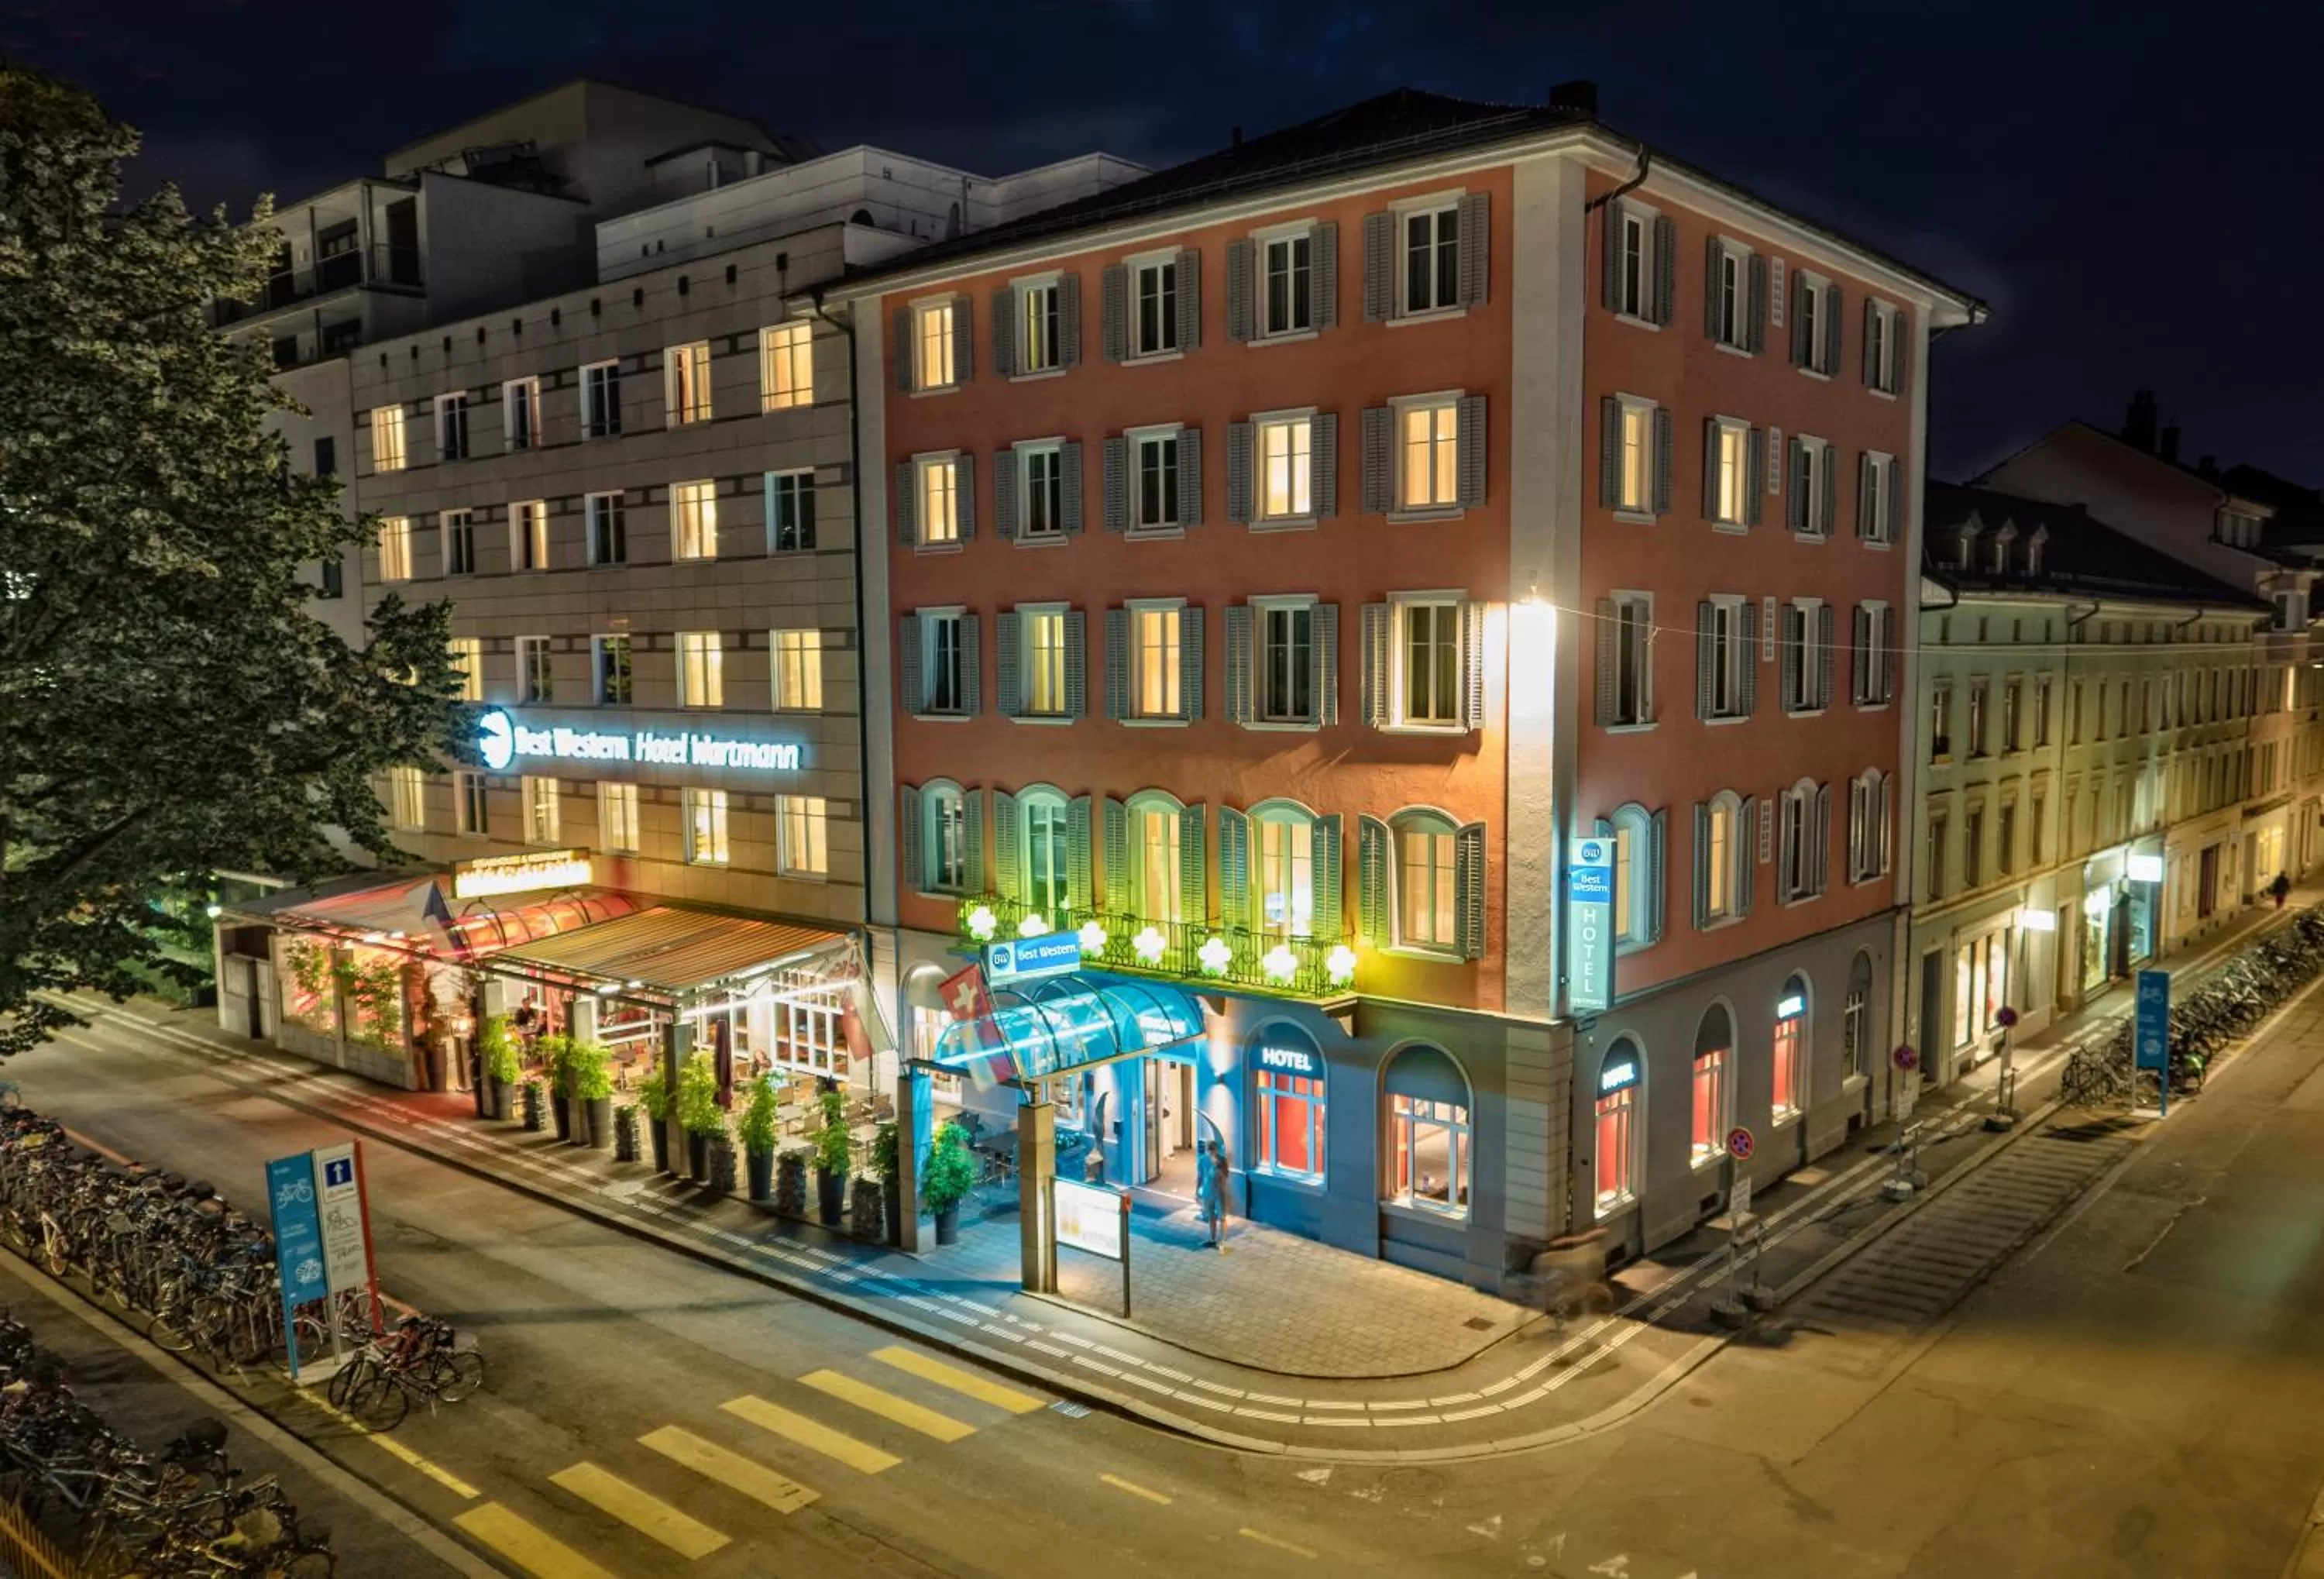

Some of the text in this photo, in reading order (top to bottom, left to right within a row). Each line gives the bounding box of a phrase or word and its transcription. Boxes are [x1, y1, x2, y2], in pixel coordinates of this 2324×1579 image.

[635, 731, 689, 764] Hotel
[1580, 873, 1602, 884] Best
[1017, 948, 1038, 961] Best
[1583, 908, 1597, 993] HOTEL
[1262, 1047, 1313, 1072] HOTEL
